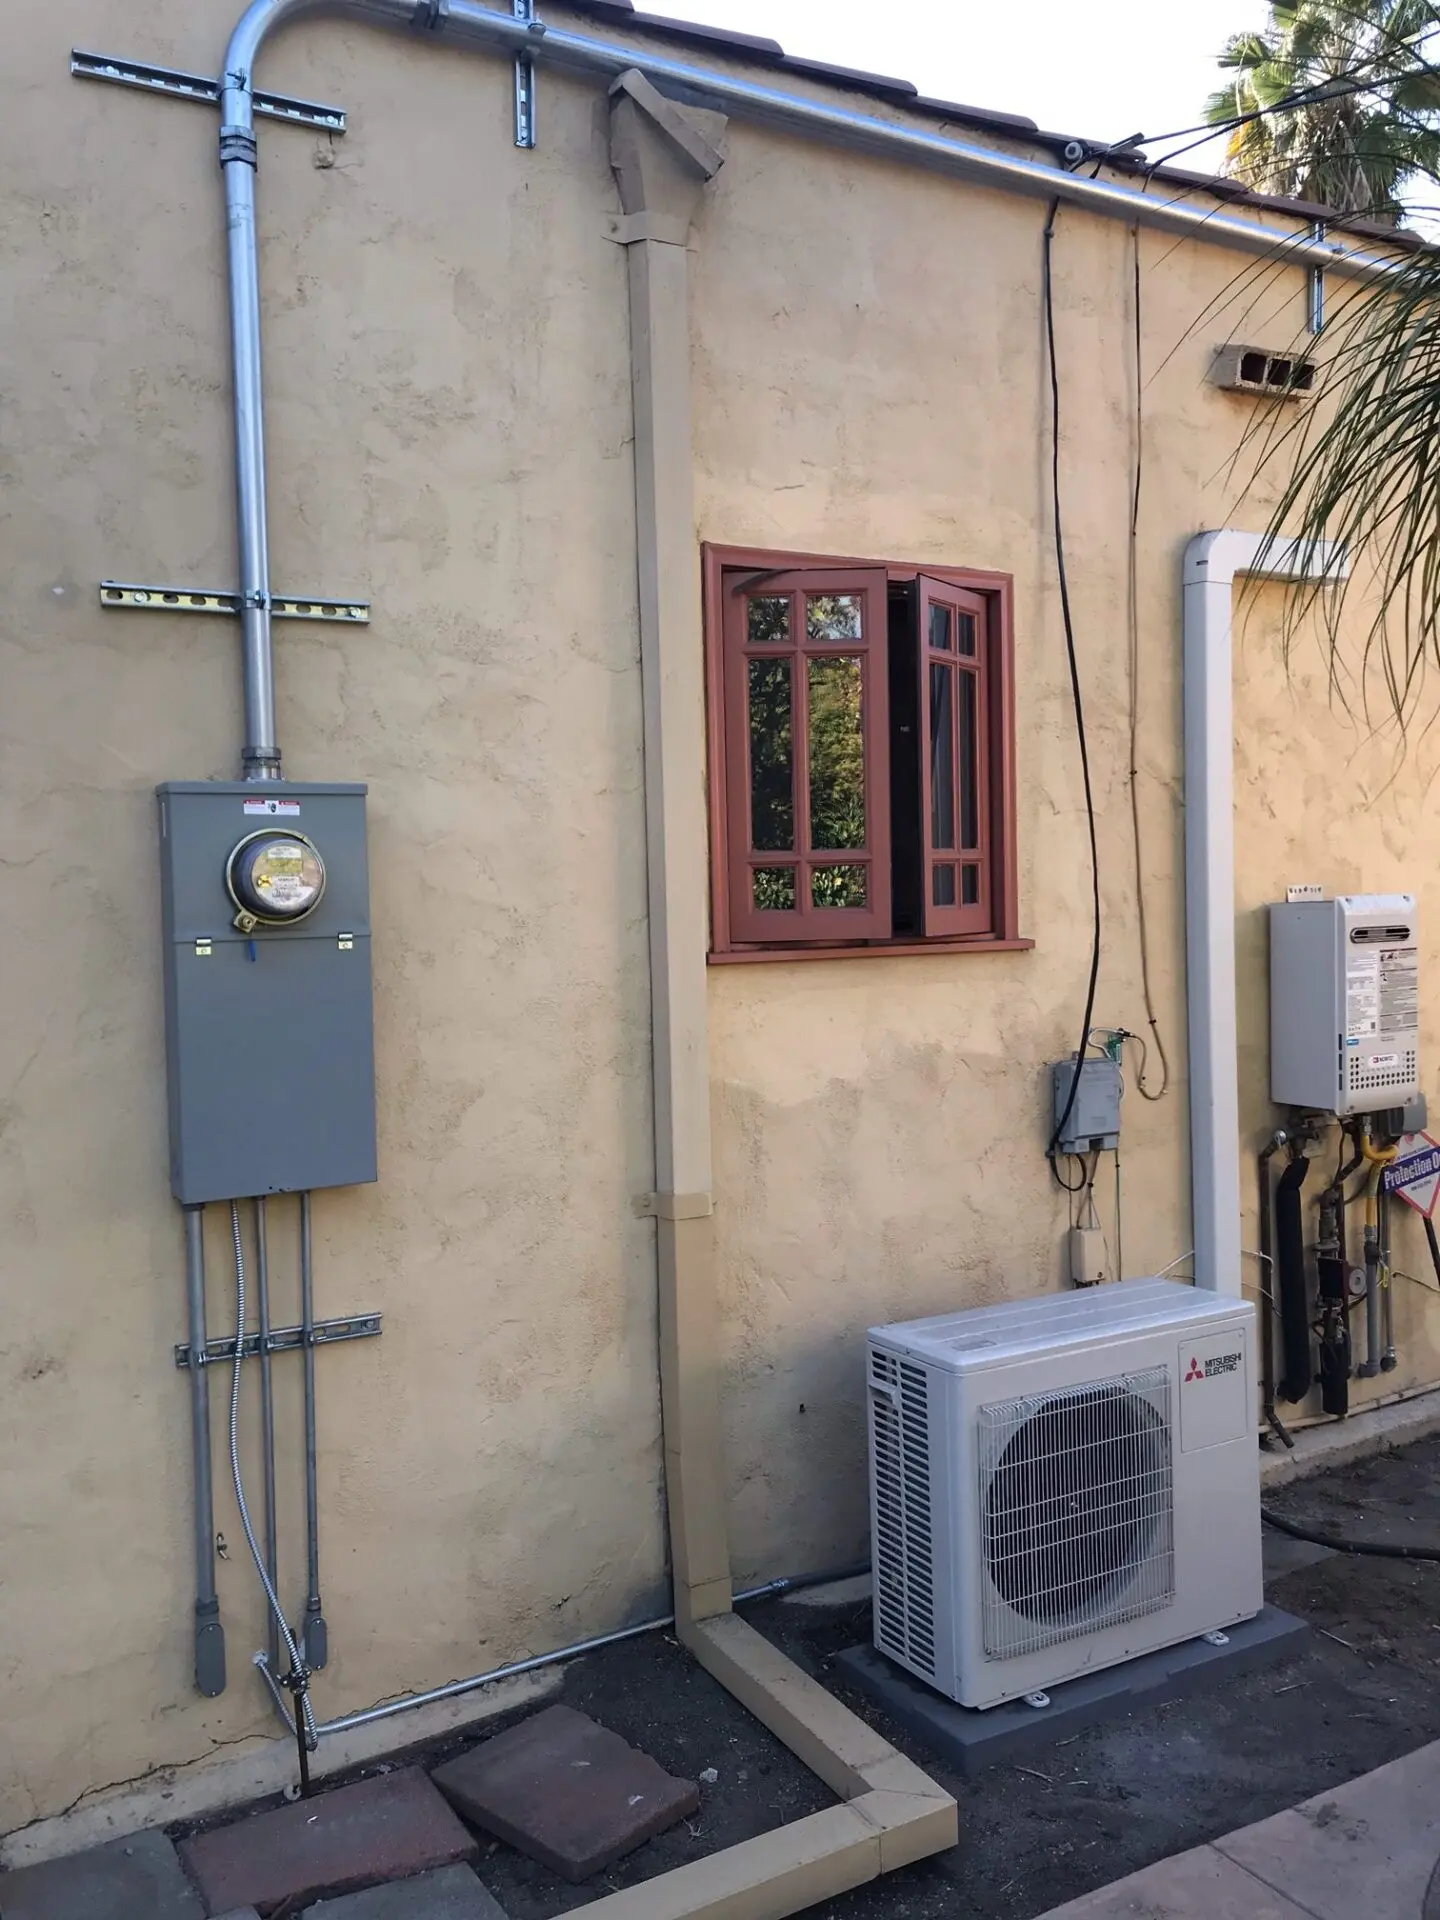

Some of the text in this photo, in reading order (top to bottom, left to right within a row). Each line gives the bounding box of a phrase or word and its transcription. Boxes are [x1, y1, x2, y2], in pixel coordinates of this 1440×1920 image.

[1384, 1158, 1432, 1189] Protection
[1432, 1151, 1440, 1169] O
[1205, 1352, 1241, 1368] MITSUBISHI
[1205, 1362, 1237, 1377] ELECTRIC
